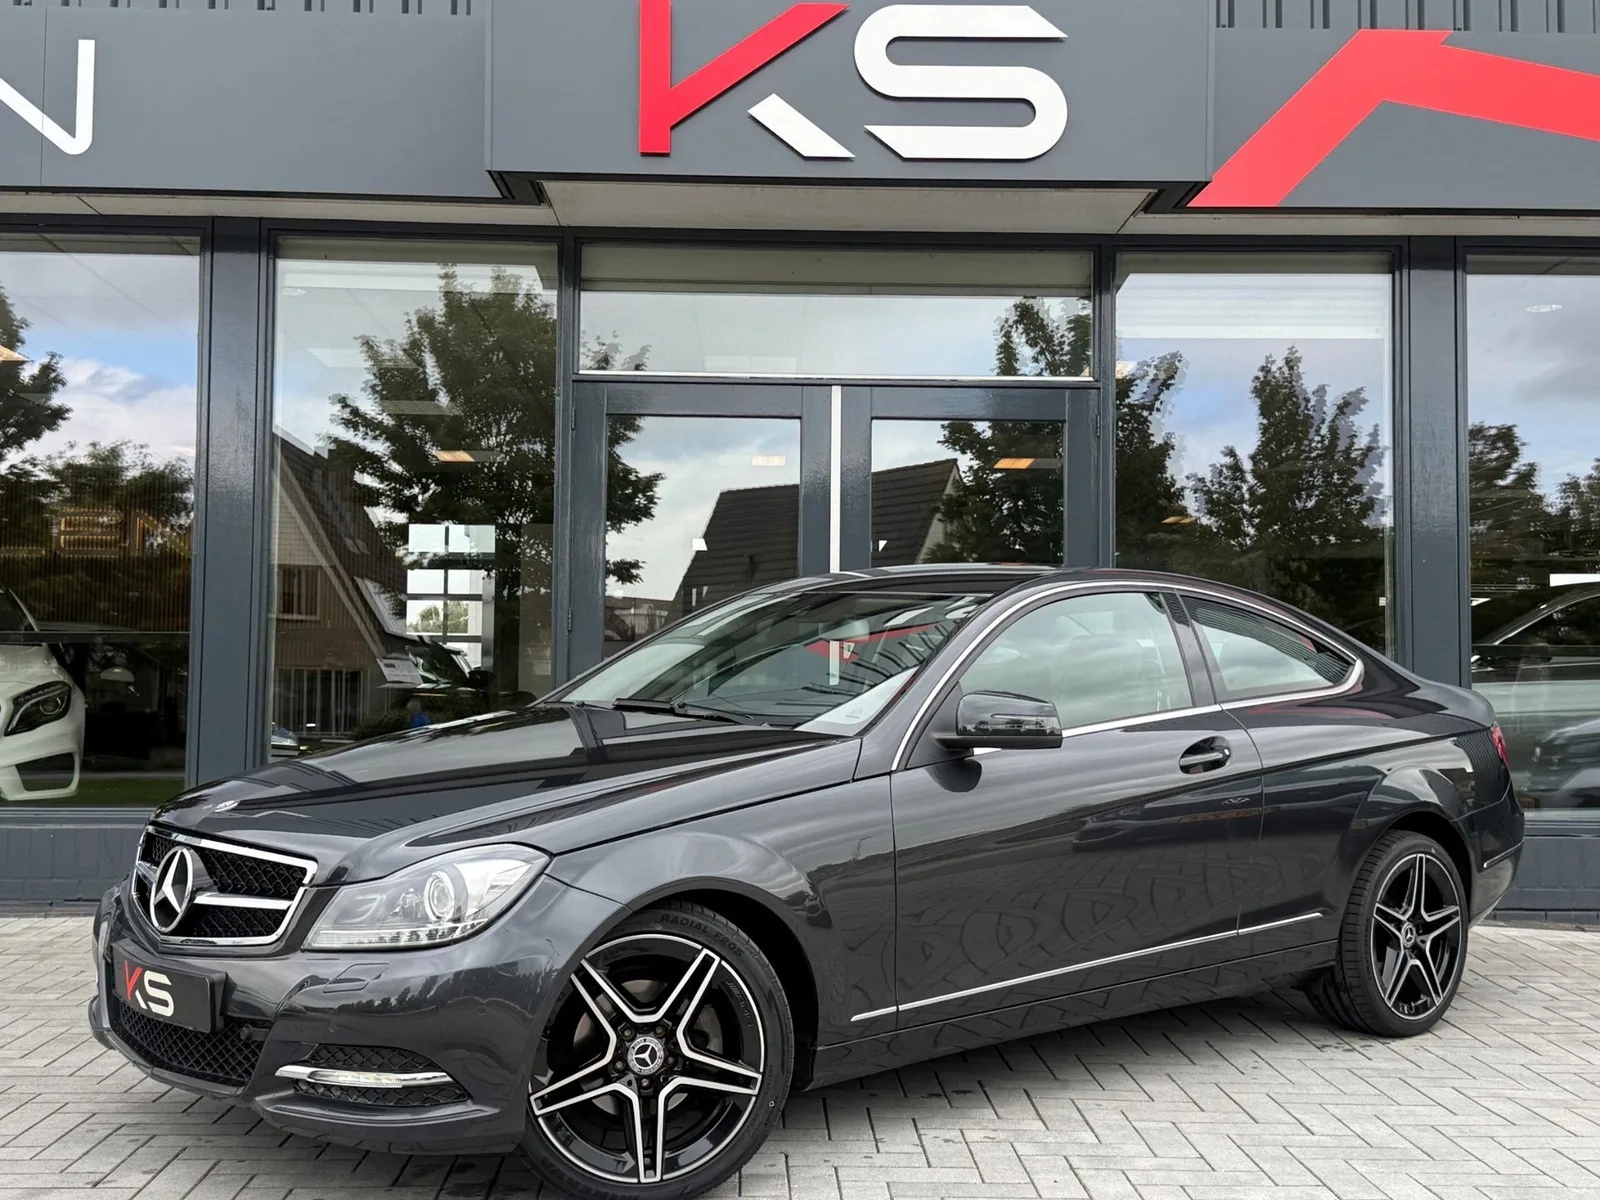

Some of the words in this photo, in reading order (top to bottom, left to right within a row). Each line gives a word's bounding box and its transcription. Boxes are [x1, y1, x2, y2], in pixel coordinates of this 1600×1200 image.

[639, 0, 1069, 160] KS
[661, 913, 709, 934] RADIAL
[124, 959, 175, 1017] KS
